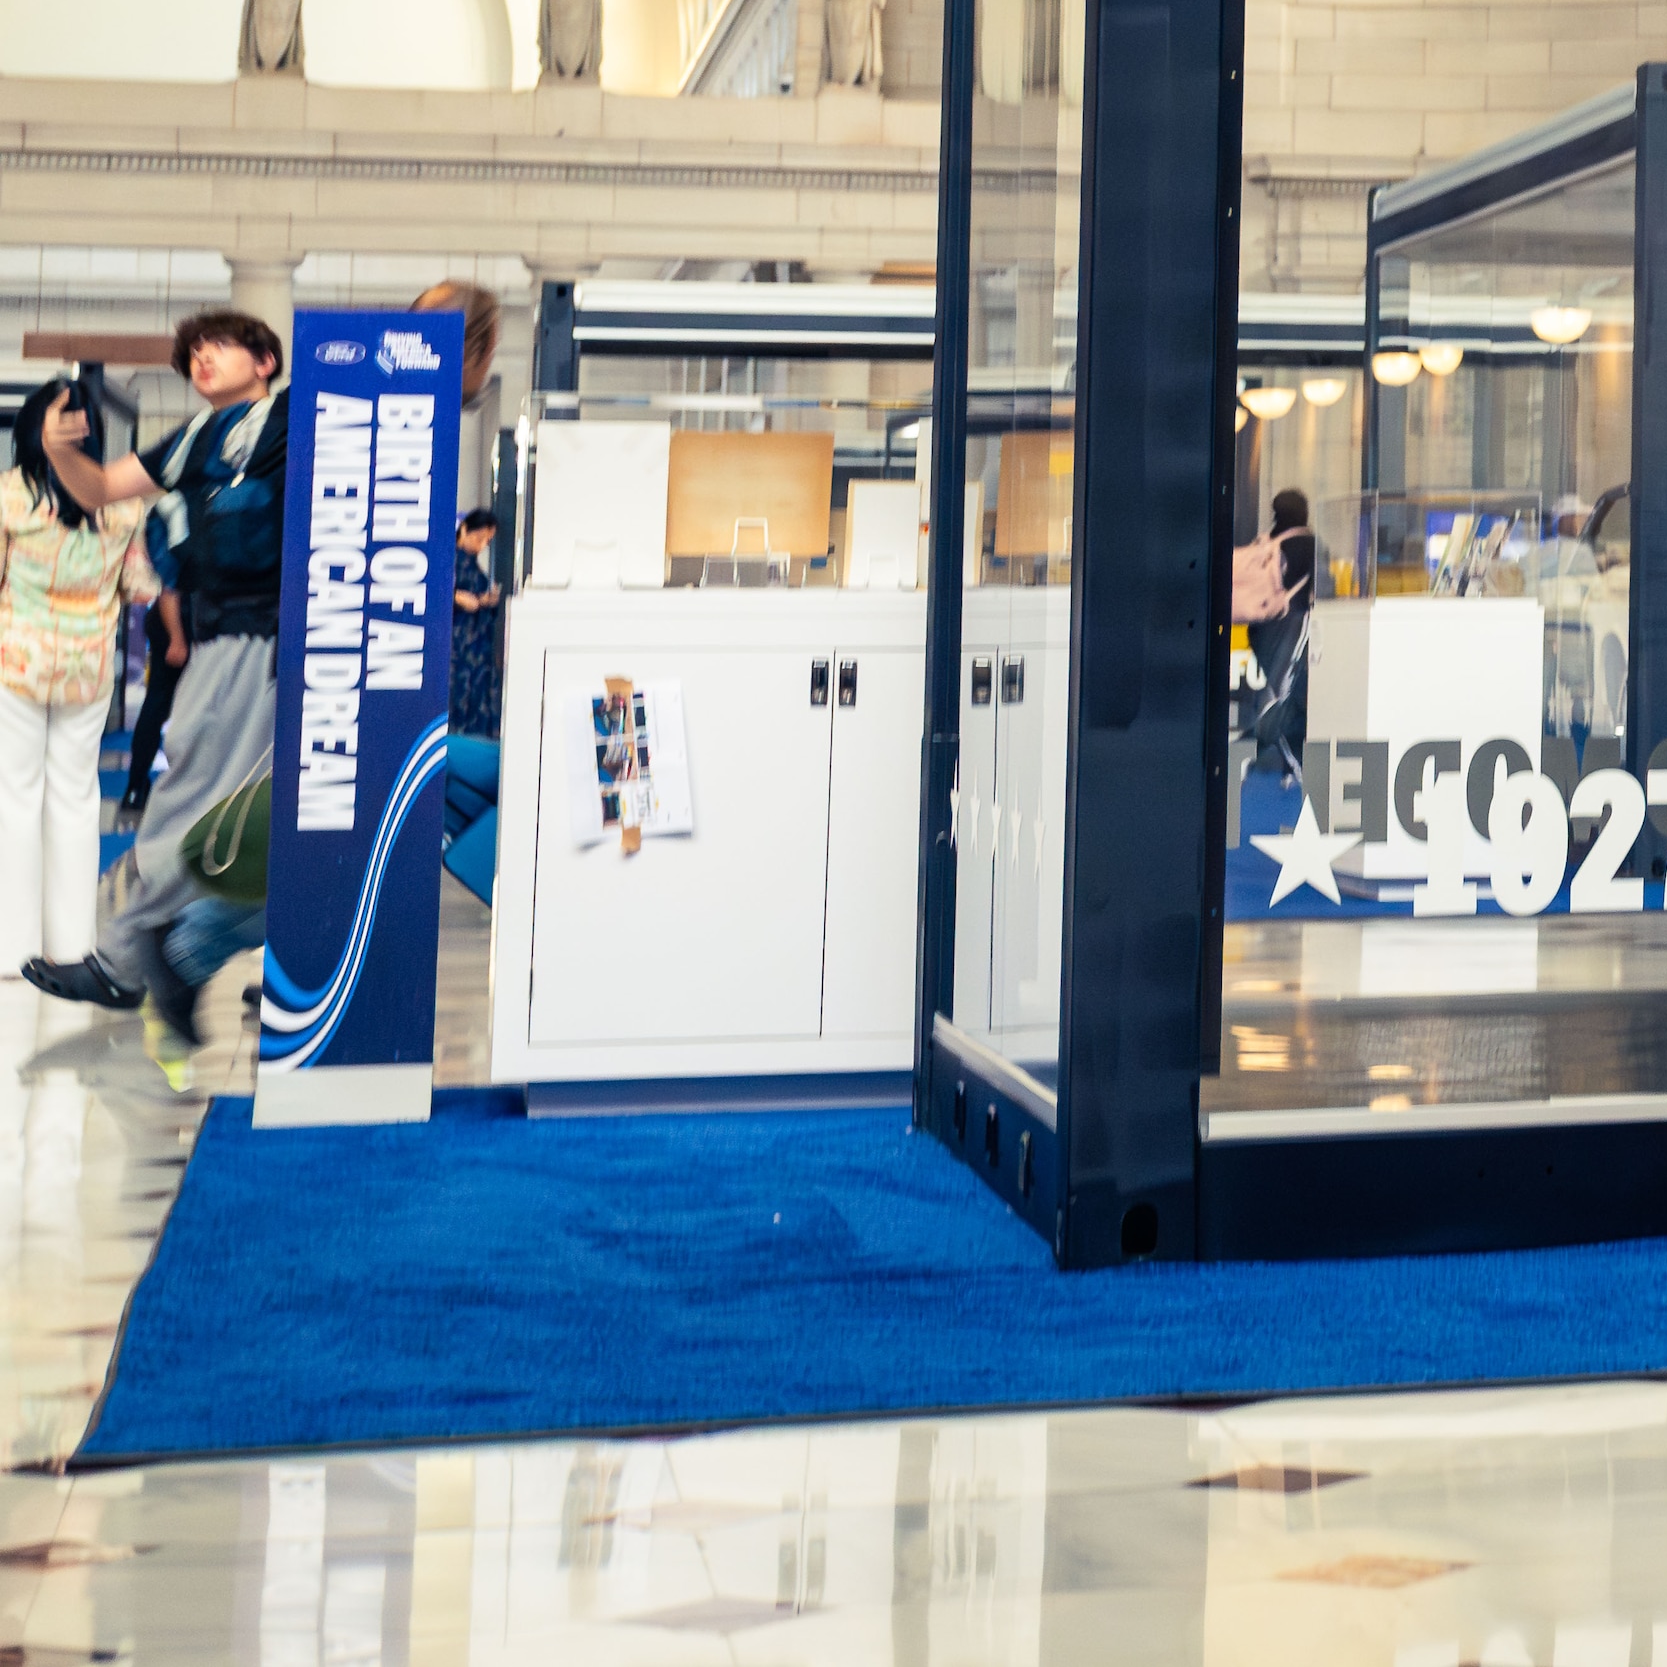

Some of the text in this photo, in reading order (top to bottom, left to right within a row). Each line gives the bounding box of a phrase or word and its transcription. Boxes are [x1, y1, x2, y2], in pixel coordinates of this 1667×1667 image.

[297, 391, 373, 831] AMERICAN DREAM
[366, 394, 435, 690] BIRTH OF AN
